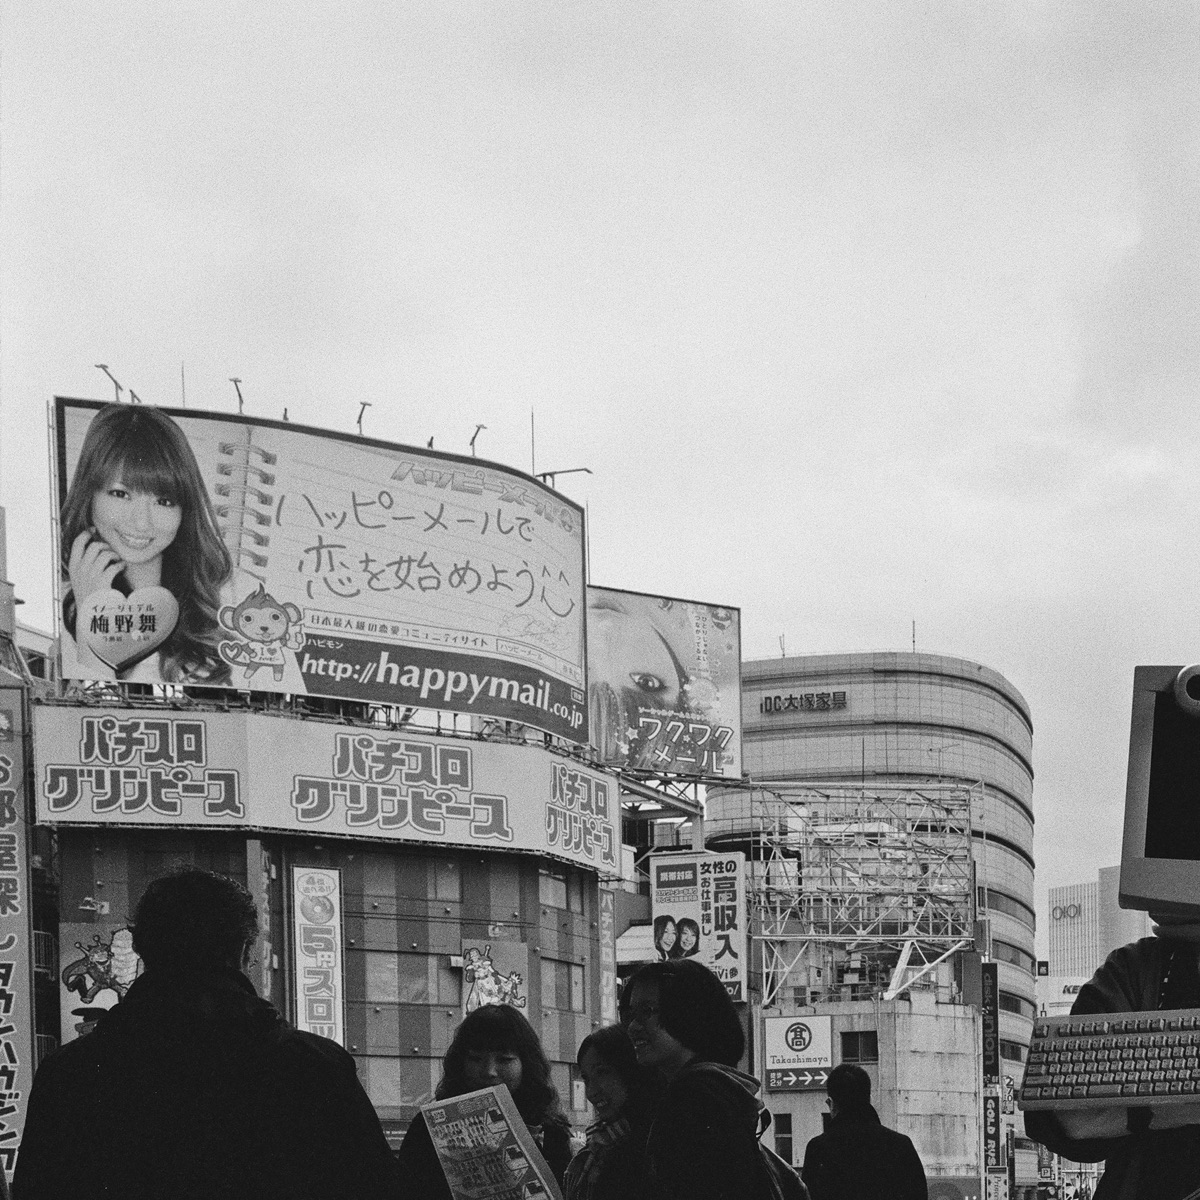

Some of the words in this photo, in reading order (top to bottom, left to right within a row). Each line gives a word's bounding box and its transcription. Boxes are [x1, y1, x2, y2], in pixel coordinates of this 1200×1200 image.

[276, 491, 535, 541] ハッピーメールで
[298, 535, 535, 608] 恋を始めよう
[90, 614, 156, 635] 梅野舞
[301, 651, 583, 729] http://happymail.co.jp
[80, 716, 207, 767] パチスロ
[638, 717, 735, 749] ワクワク
[334, 734, 471, 790] パチスロ
[654, 745, 724, 775] メール
[44, 765, 244, 818] グリンピース
[291, 776, 512, 841] グリンピース
[551, 763, 608, 821] パチスロ
[546, 809, 616, 868] グリンピース
[700, 860, 737, 875] 女性の
[701, 877, 712, 936] お仕事探し
[713, 876, 739, 960] 高収入
[301, 924, 336, 1040] 5円スロッ
[1062, 985, 1081, 994] KE
[770, 1055, 829, 1065] Takashimaya
[986, 1099, 996, 1134] GOLD
